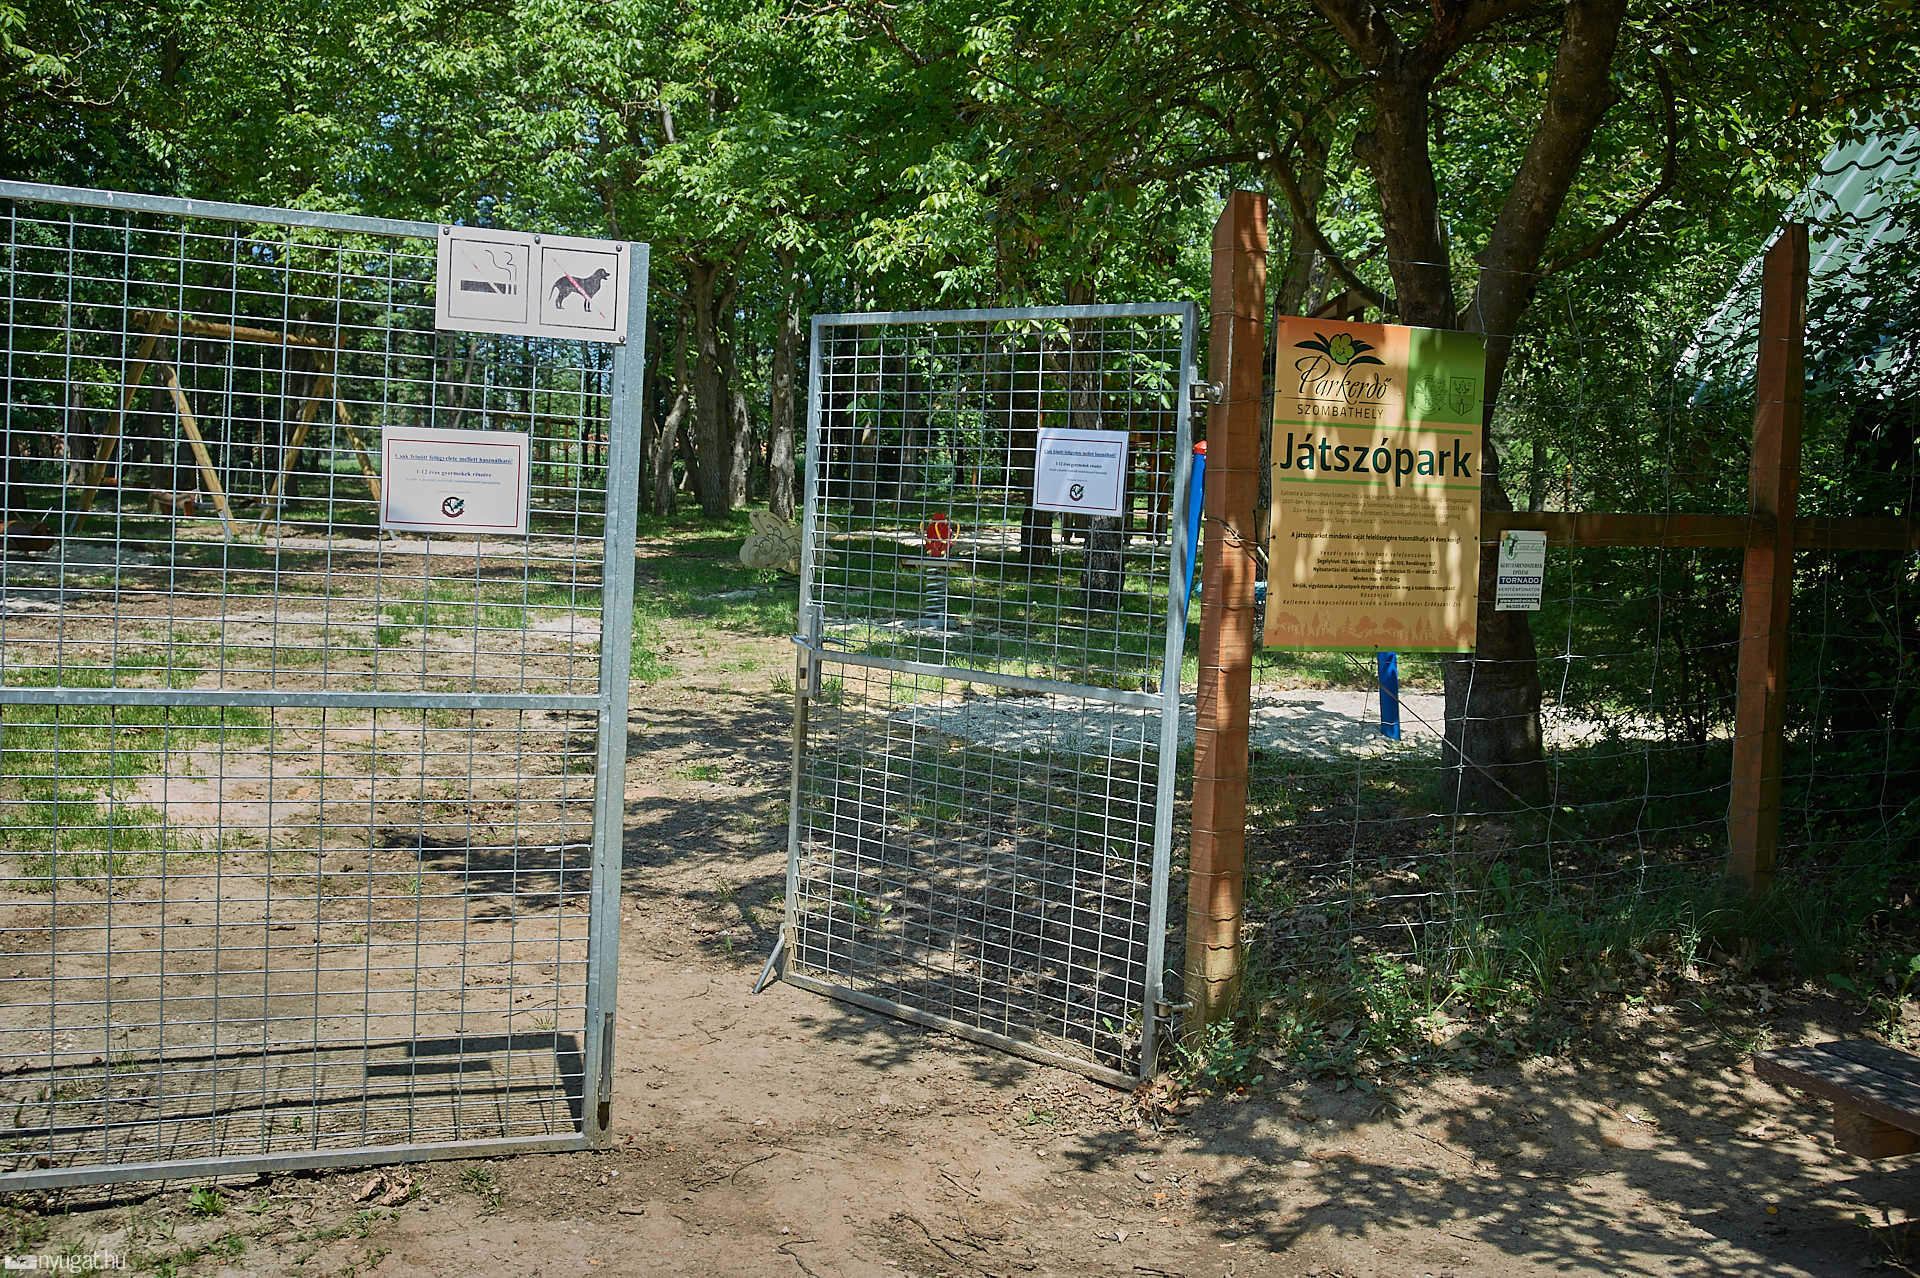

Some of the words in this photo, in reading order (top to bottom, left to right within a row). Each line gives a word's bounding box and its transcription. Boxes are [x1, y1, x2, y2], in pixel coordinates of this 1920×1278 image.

[1295, 355, 1392, 405] Parkerdő
[1297, 404, 1384, 419] SZOMBATHELY
[1280, 433, 1473, 487] Játszópark
